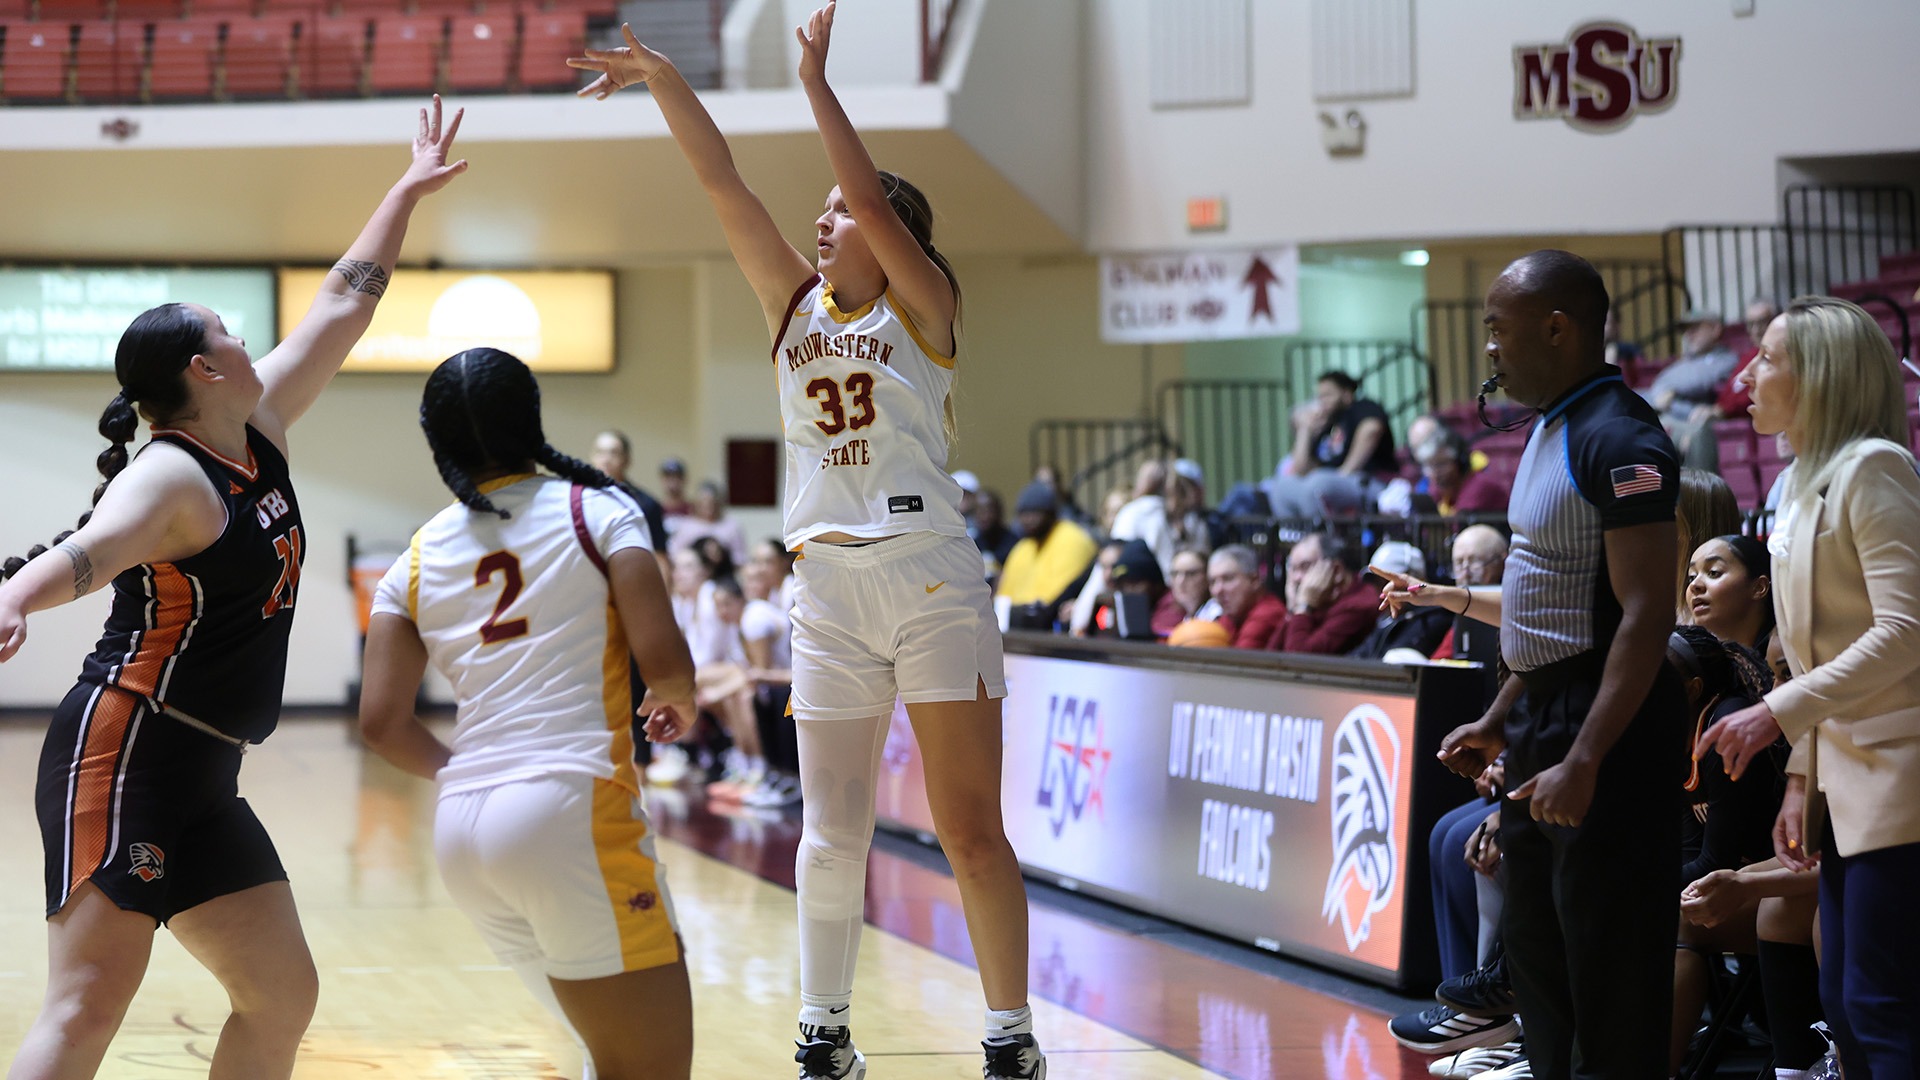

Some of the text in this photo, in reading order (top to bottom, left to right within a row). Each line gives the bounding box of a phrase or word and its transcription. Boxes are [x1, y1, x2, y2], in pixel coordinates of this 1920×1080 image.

[1513, 21, 1681, 134] MSU
[785, 331, 895, 373] MIDWESTERN
[805, 371, 877, 437] 33
[821, 439, 871, 471] STATE
[911, 500, 919, 508] M
[473, 549, 530, 646] 2
[1037, 693, 1099, 841] LSC
[1168, 701, 1324, 804] UT PERMIAN BASIN
[1196, 798, 1275, 892] FALCONS
